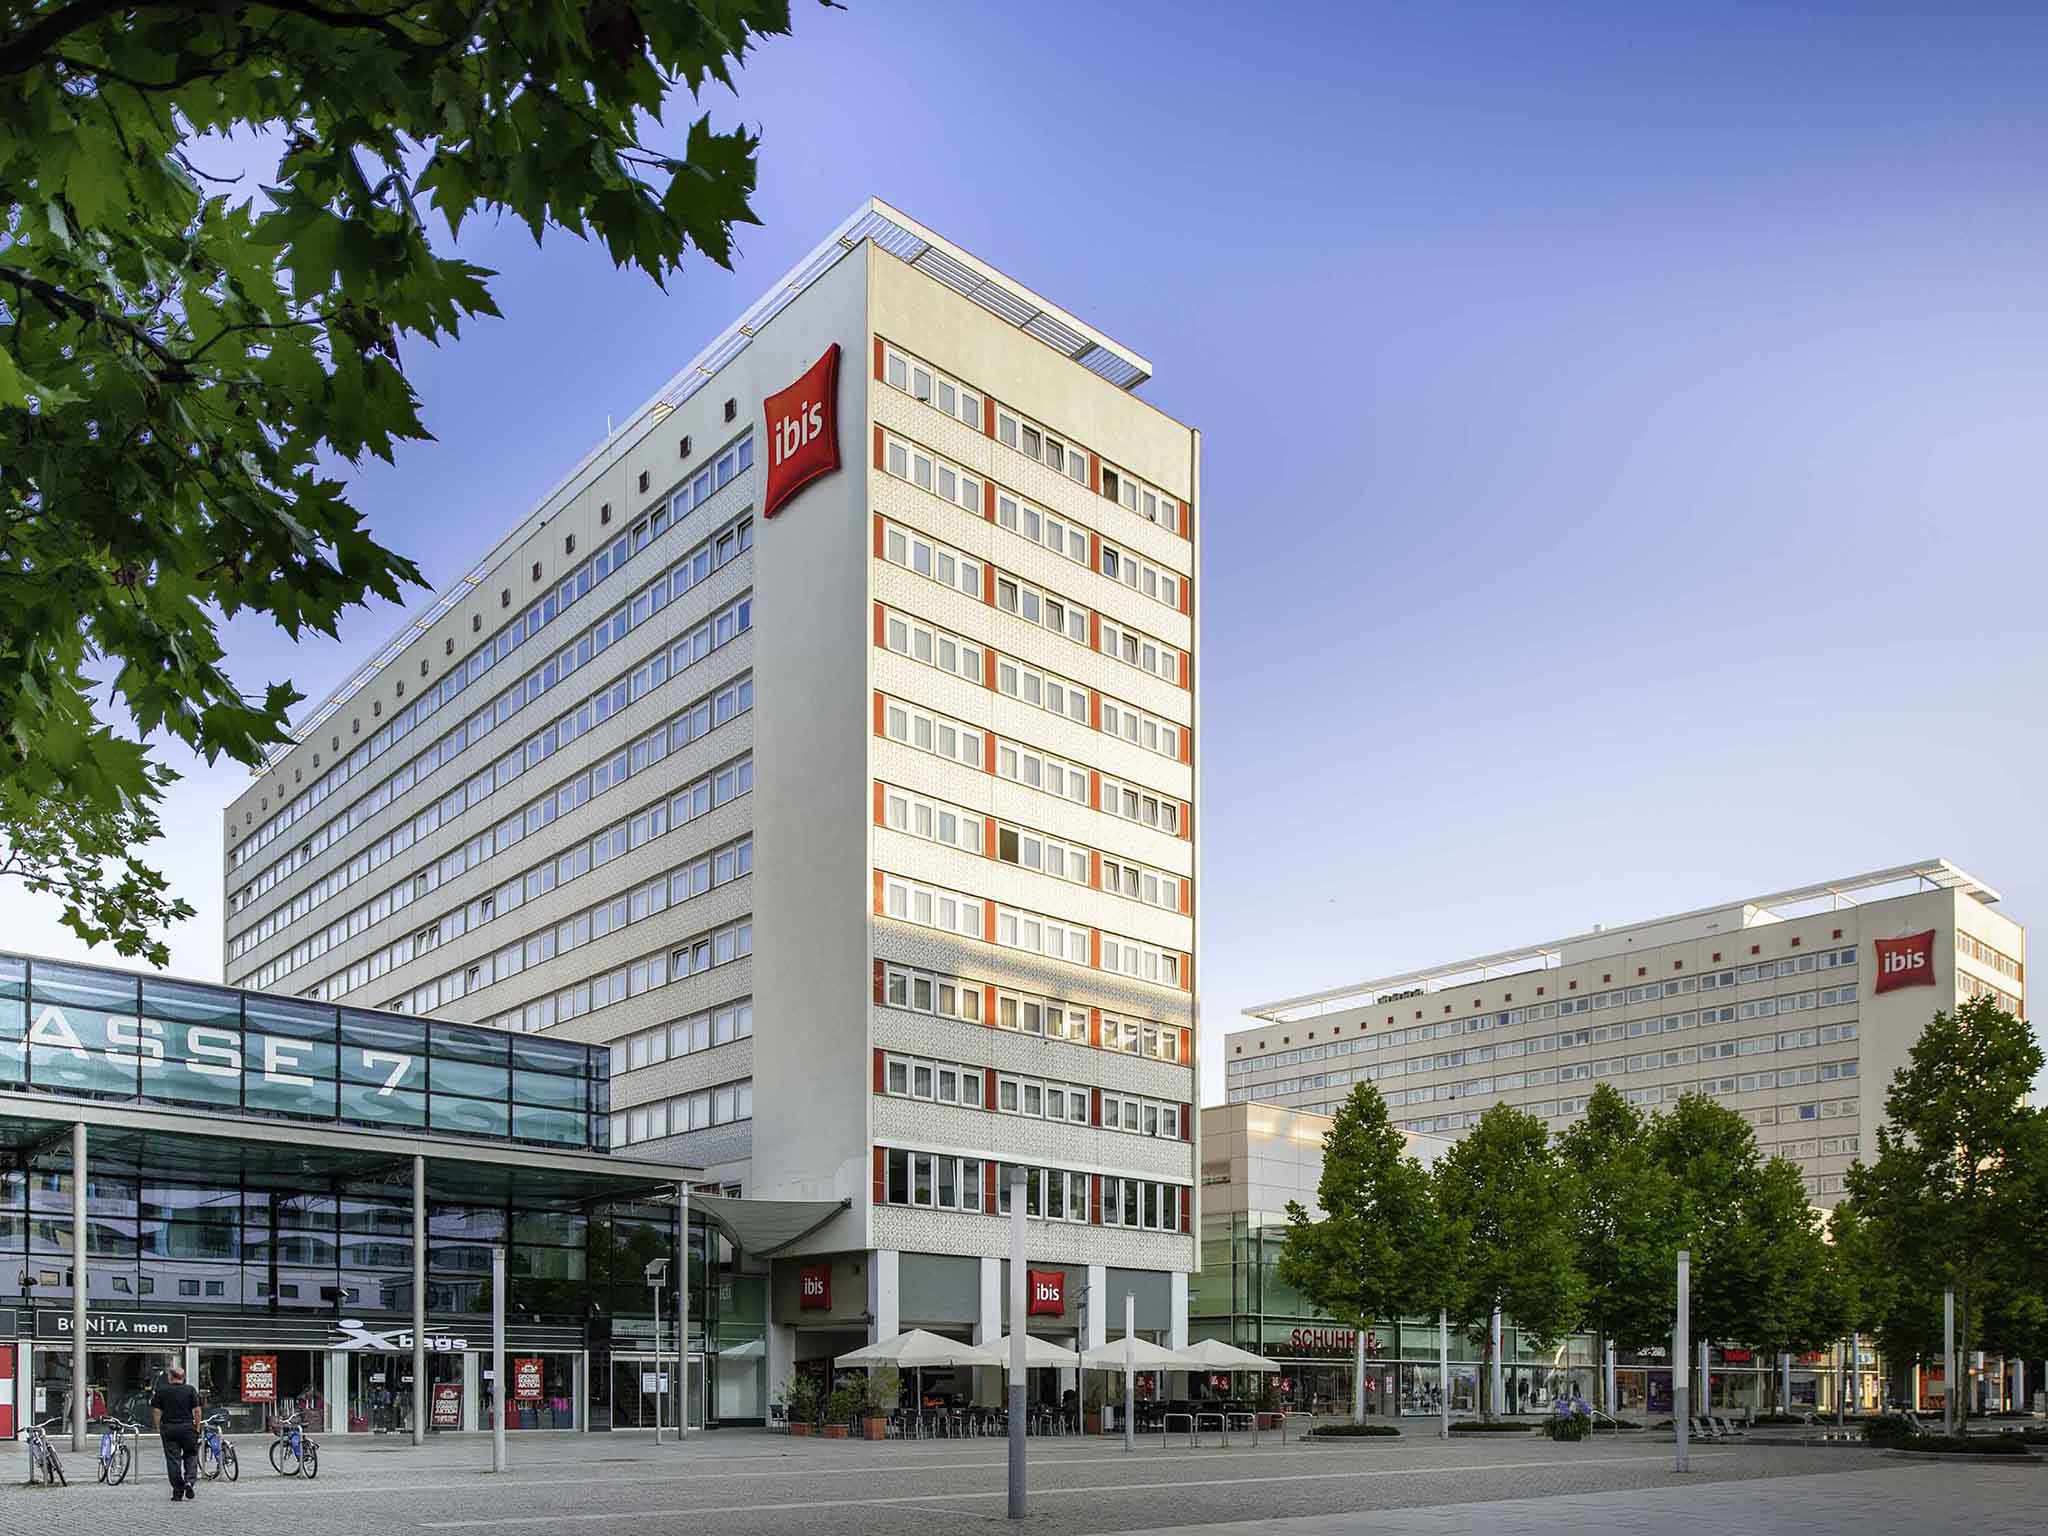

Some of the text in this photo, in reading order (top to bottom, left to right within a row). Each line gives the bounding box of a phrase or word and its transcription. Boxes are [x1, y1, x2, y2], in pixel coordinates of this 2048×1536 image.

[775, 401, 823, 466] ibis
[1884, 948, 1926, 974] ibis
[17, 1005, 412, 1097] ASSE 7
[804, 1278, 824, 1296] ibis
[1036, 1282, 1060, 1301] ibis
[133, 1323, 168, 1334] men
[1290, 1328, 1376, 1349] SCHUHHF
